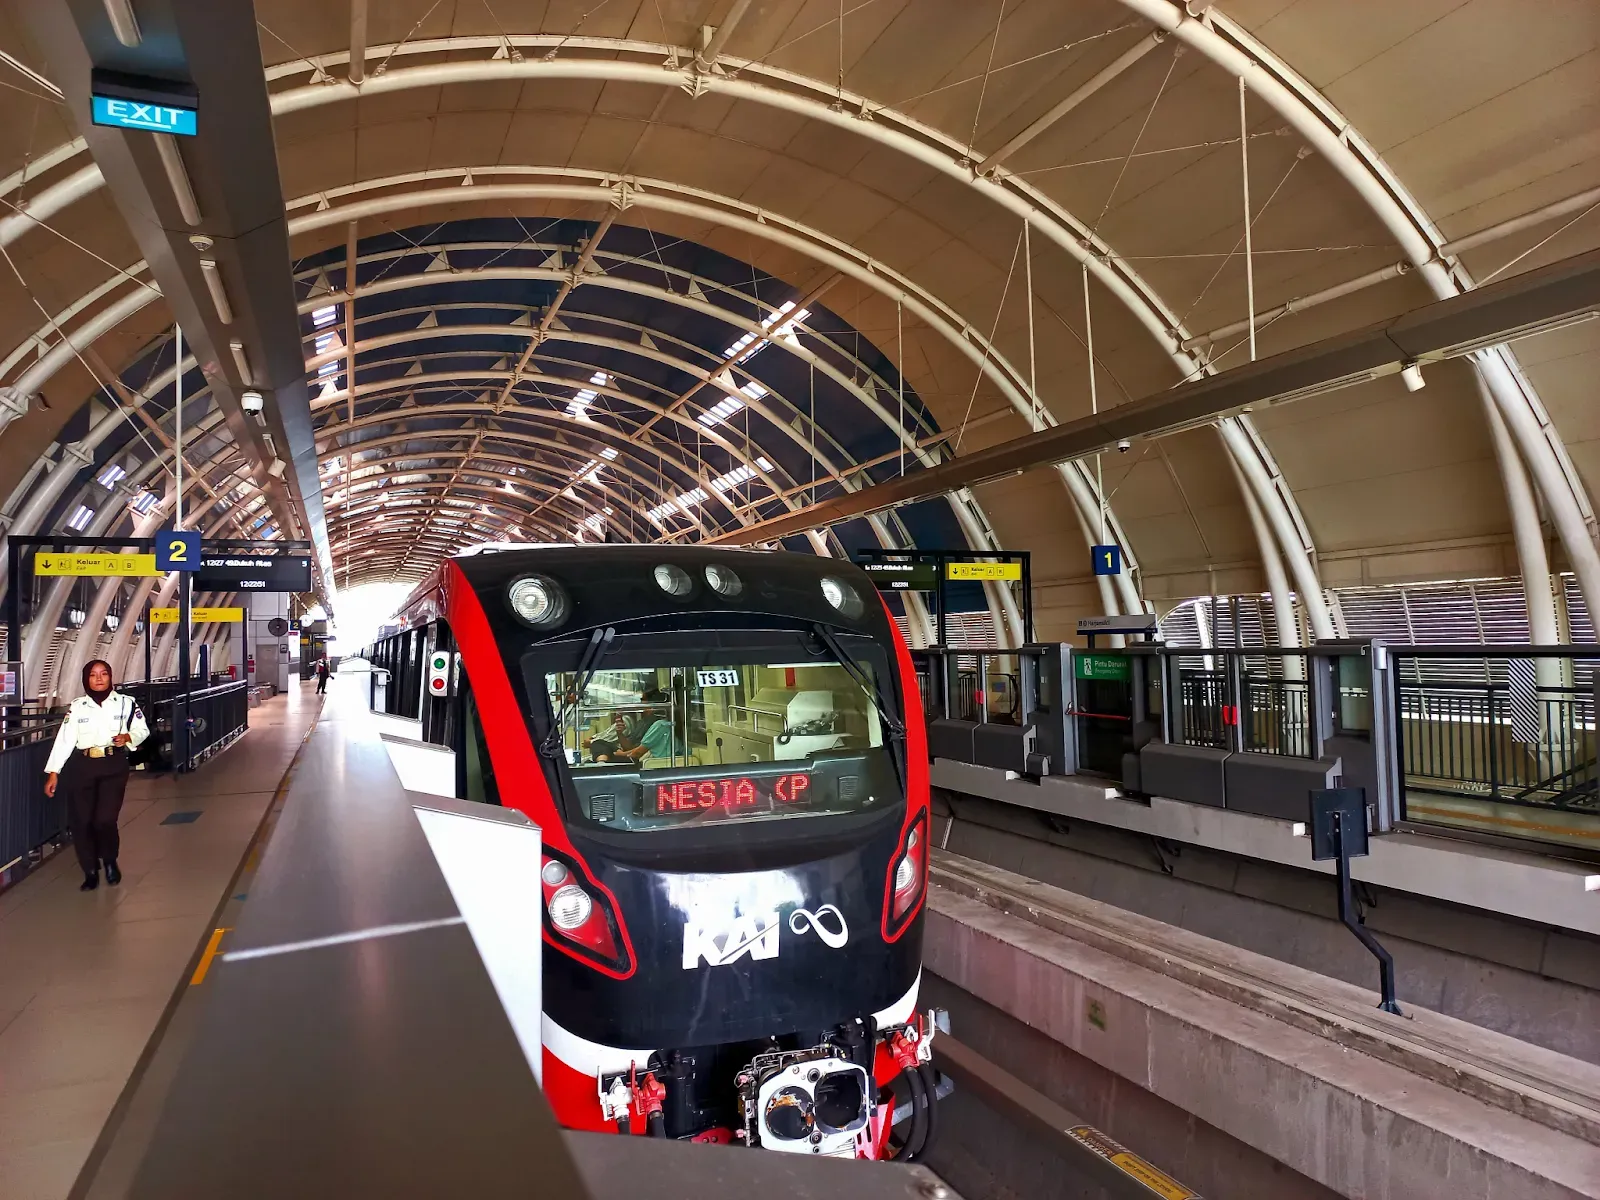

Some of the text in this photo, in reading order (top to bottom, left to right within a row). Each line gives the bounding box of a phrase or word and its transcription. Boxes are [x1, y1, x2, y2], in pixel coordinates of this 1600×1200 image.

[107, 99, 184, 125] EXIT
[169, 540, 187, 562] 2
[1104, 552, 1112, 568] 1
[293, 621, 299, 629] 2
[699, 672, 735, 685] TS 31
[657, 779, 754, 812] NESIA
[682, 911, 780, 971] KAI
